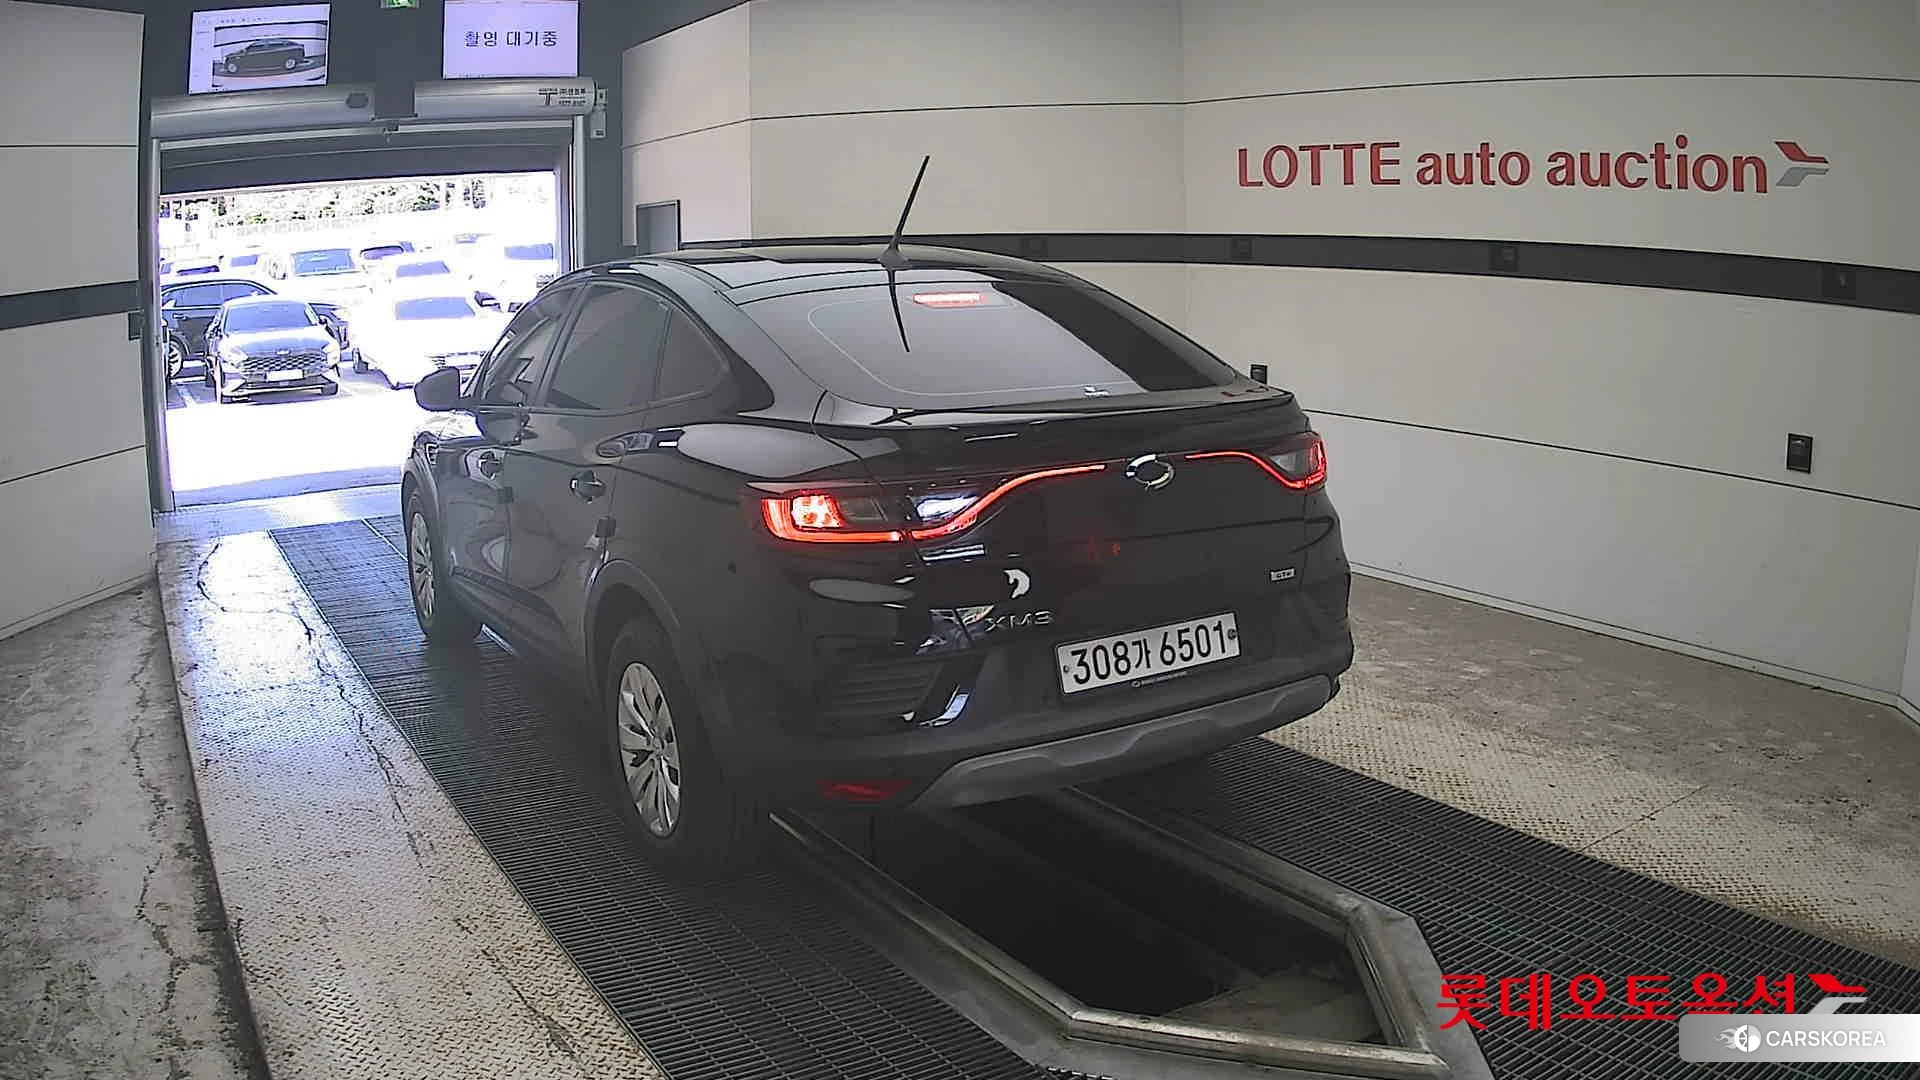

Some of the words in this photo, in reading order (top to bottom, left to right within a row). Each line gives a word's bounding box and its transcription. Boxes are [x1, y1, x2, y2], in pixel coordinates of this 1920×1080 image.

[506, 31, 558, 47] 대기중
[1238, 141, 1401, 188] LOTTE
[1416, 142, 1531, 186] auto
[1546, 134, 1768, 194] auction
[984, 610, 1051, 632] XM3
[1071, 637, 1152, 685] 308가
[1159, 620, 1227, 666] 6501
